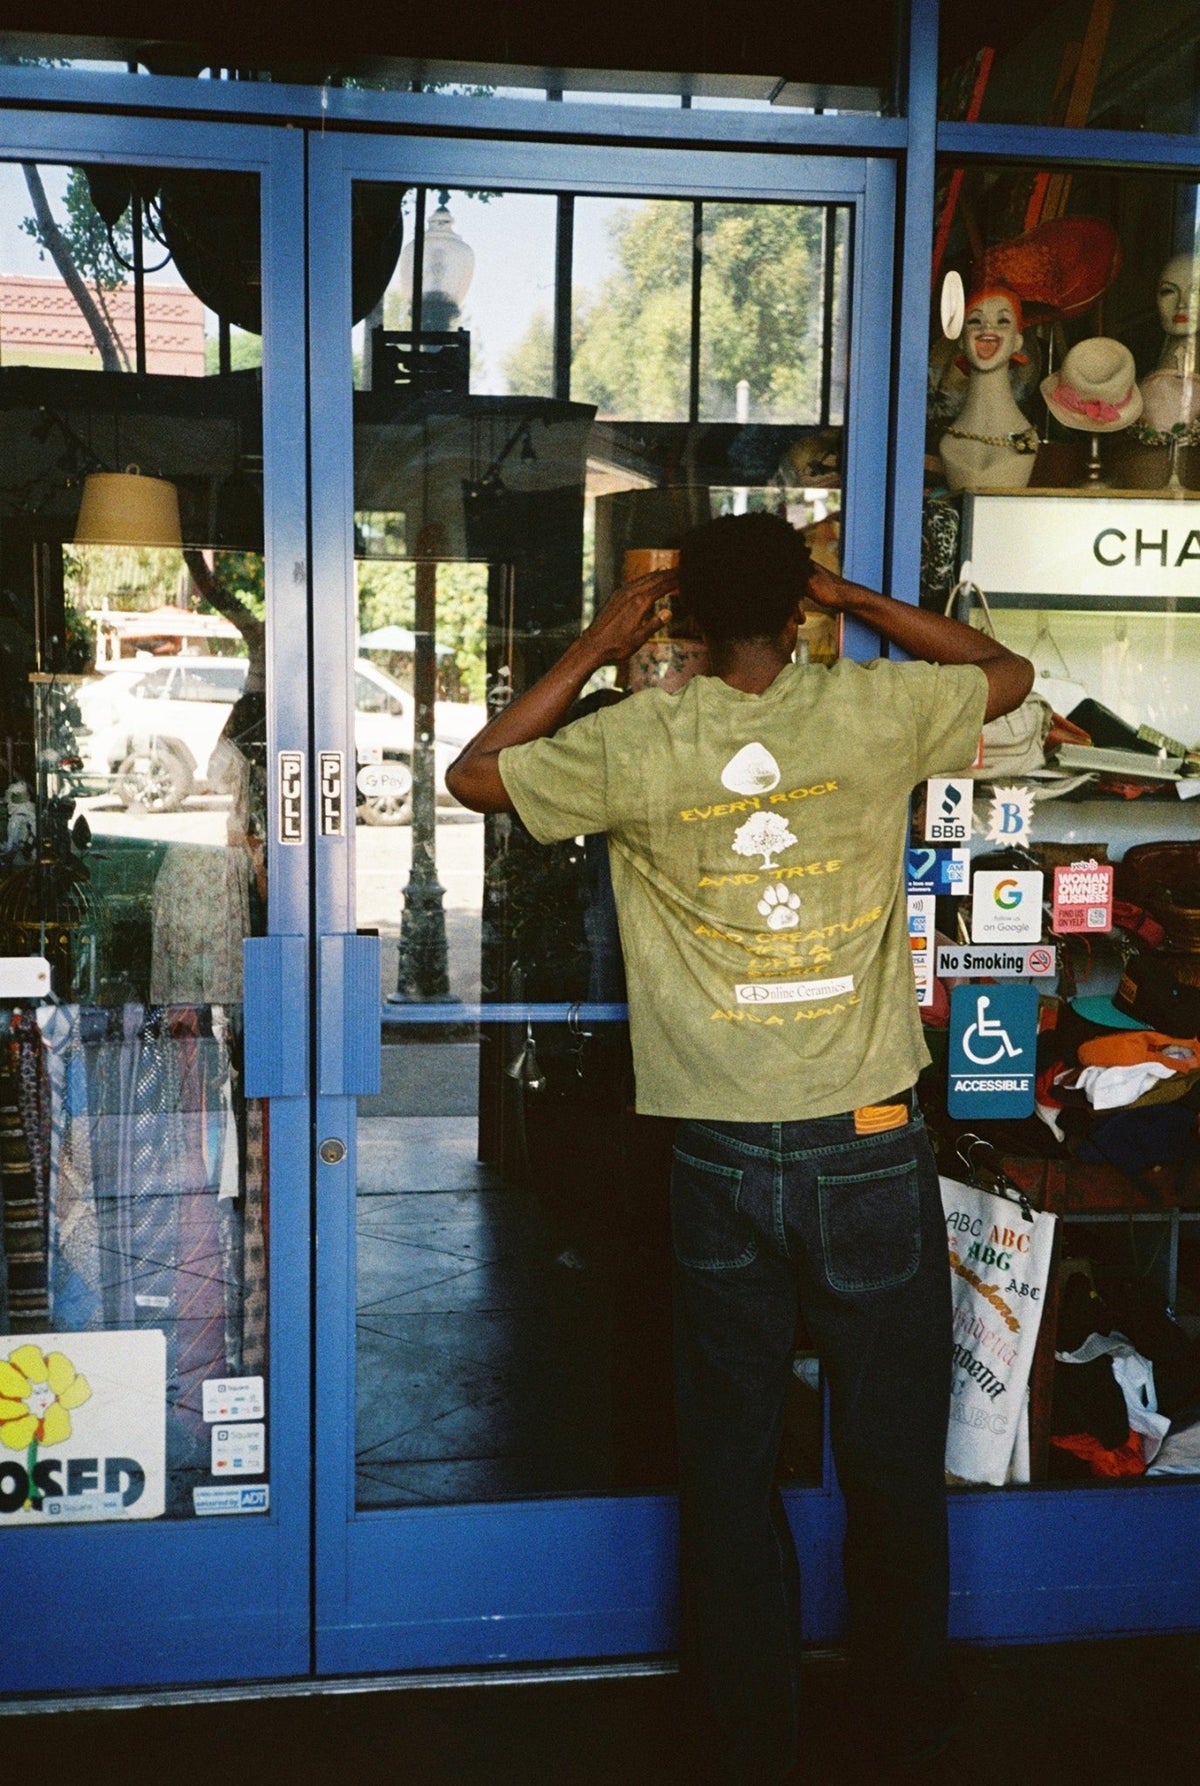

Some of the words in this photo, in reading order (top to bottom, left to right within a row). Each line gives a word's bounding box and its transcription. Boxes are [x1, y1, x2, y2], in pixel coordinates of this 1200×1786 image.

[1092, 527, 1200, 567] CHA
[381, 775, 402, 788] Pay
[282, 761, 300, 836] PULL
[322, 760, 340, 835] PULL
[680, 797, 760, 821] EVERY
[769, 780, 839, 804] ROCK
[1001, 803, 1023, 833] B
[931, 825, 966, 838] BBB
[698, 873, 760, 887] AND
[768, 860, 842, 880] TREE
[1058, 873, 1109, 884] WOMAN
[1058, 884, 1108, 894] OWNED
[1058, 894, 1109, 904] BUSINESS
[755, 906, 883, 943] CREATURE
[997, 922, 1030, 933] Google
[1068, 919, 1085, 927] YELP
[940, 954, 958, 970] No
[963, 954, 1024, 973] Smoking
[797, 982, 846, 998] Ceramics
[954, 1079, 1029, 1092] ACCESSIBLE
[946, 1211, 982, 1236] ABC
[989, 1224, 1031, 1253] ABC
[968, 1240, 1012, 1271] ABC
[1005, 1279, 1040, 1300] ABC
